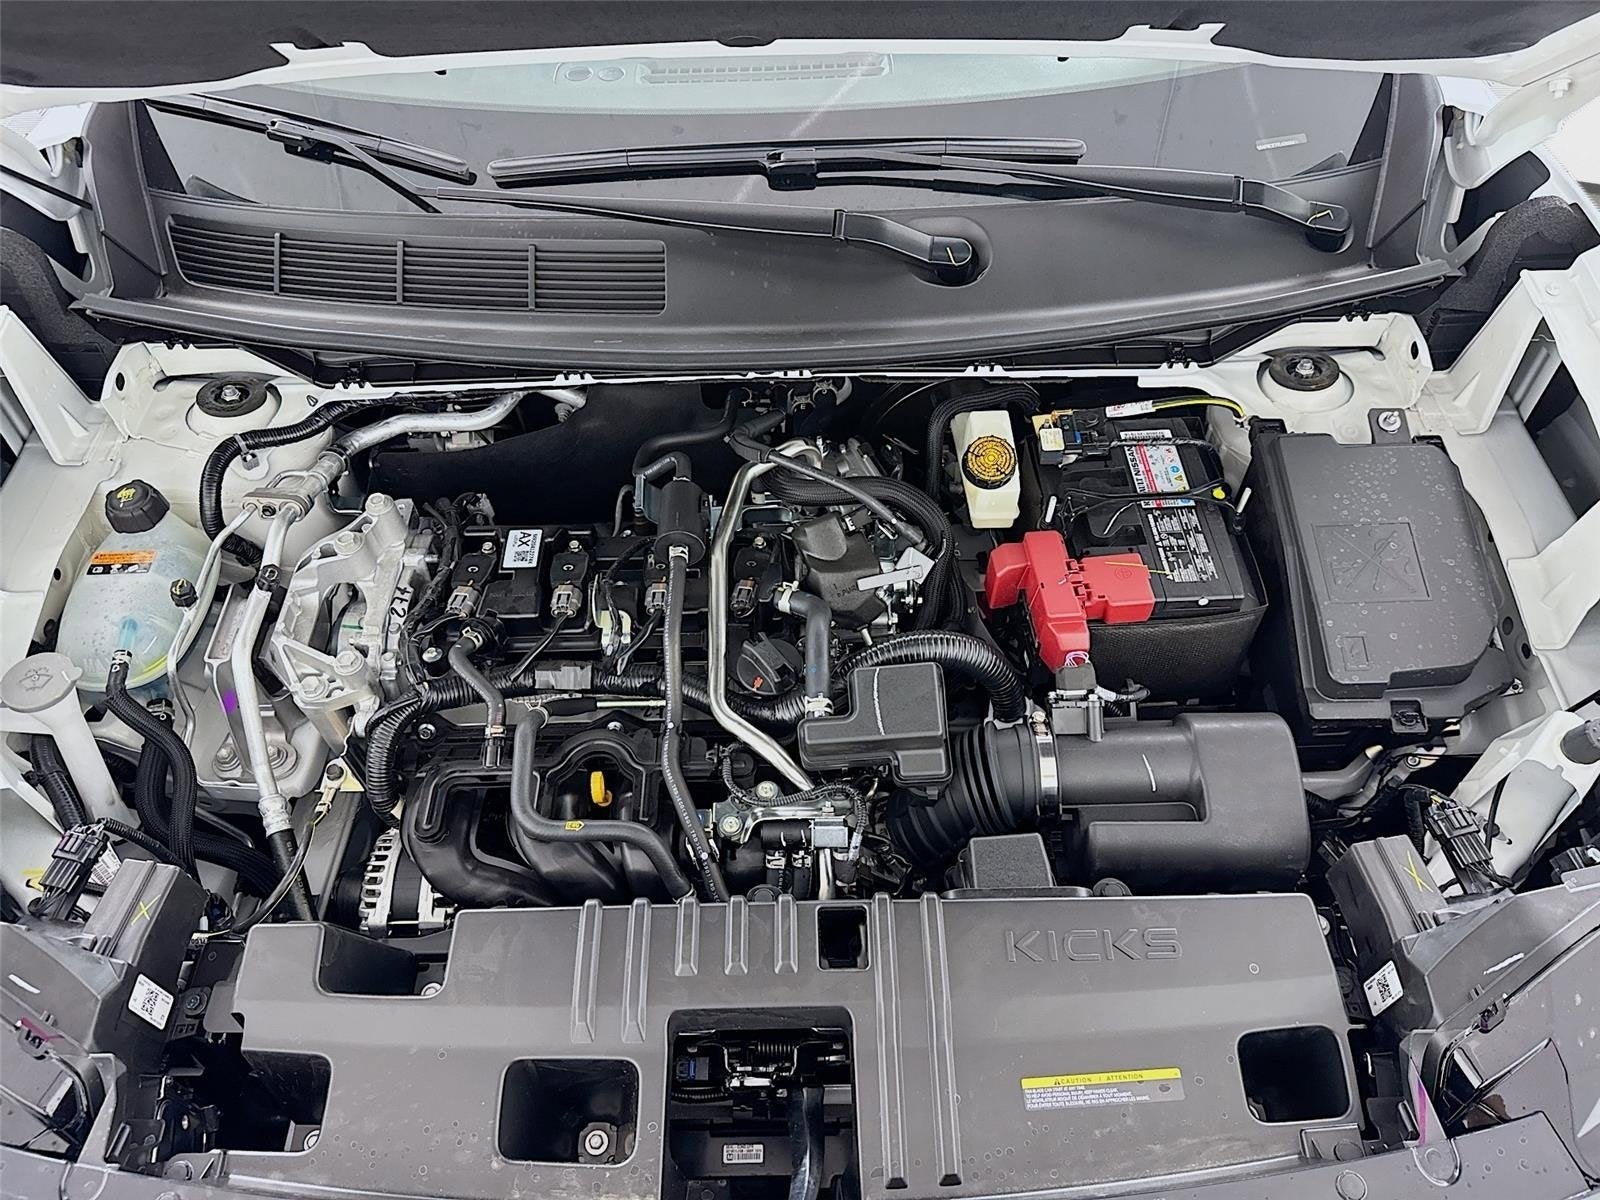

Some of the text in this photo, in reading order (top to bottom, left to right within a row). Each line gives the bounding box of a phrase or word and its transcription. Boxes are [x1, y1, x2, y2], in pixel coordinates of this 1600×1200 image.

[1126, 446, 1141, 478] NISSAN
[518, 531, 532, 547] AX
[1005, 928, 1183, 963] KICKS
[1060, 1073, 1144, 1085] CAUTION ATTENTION
